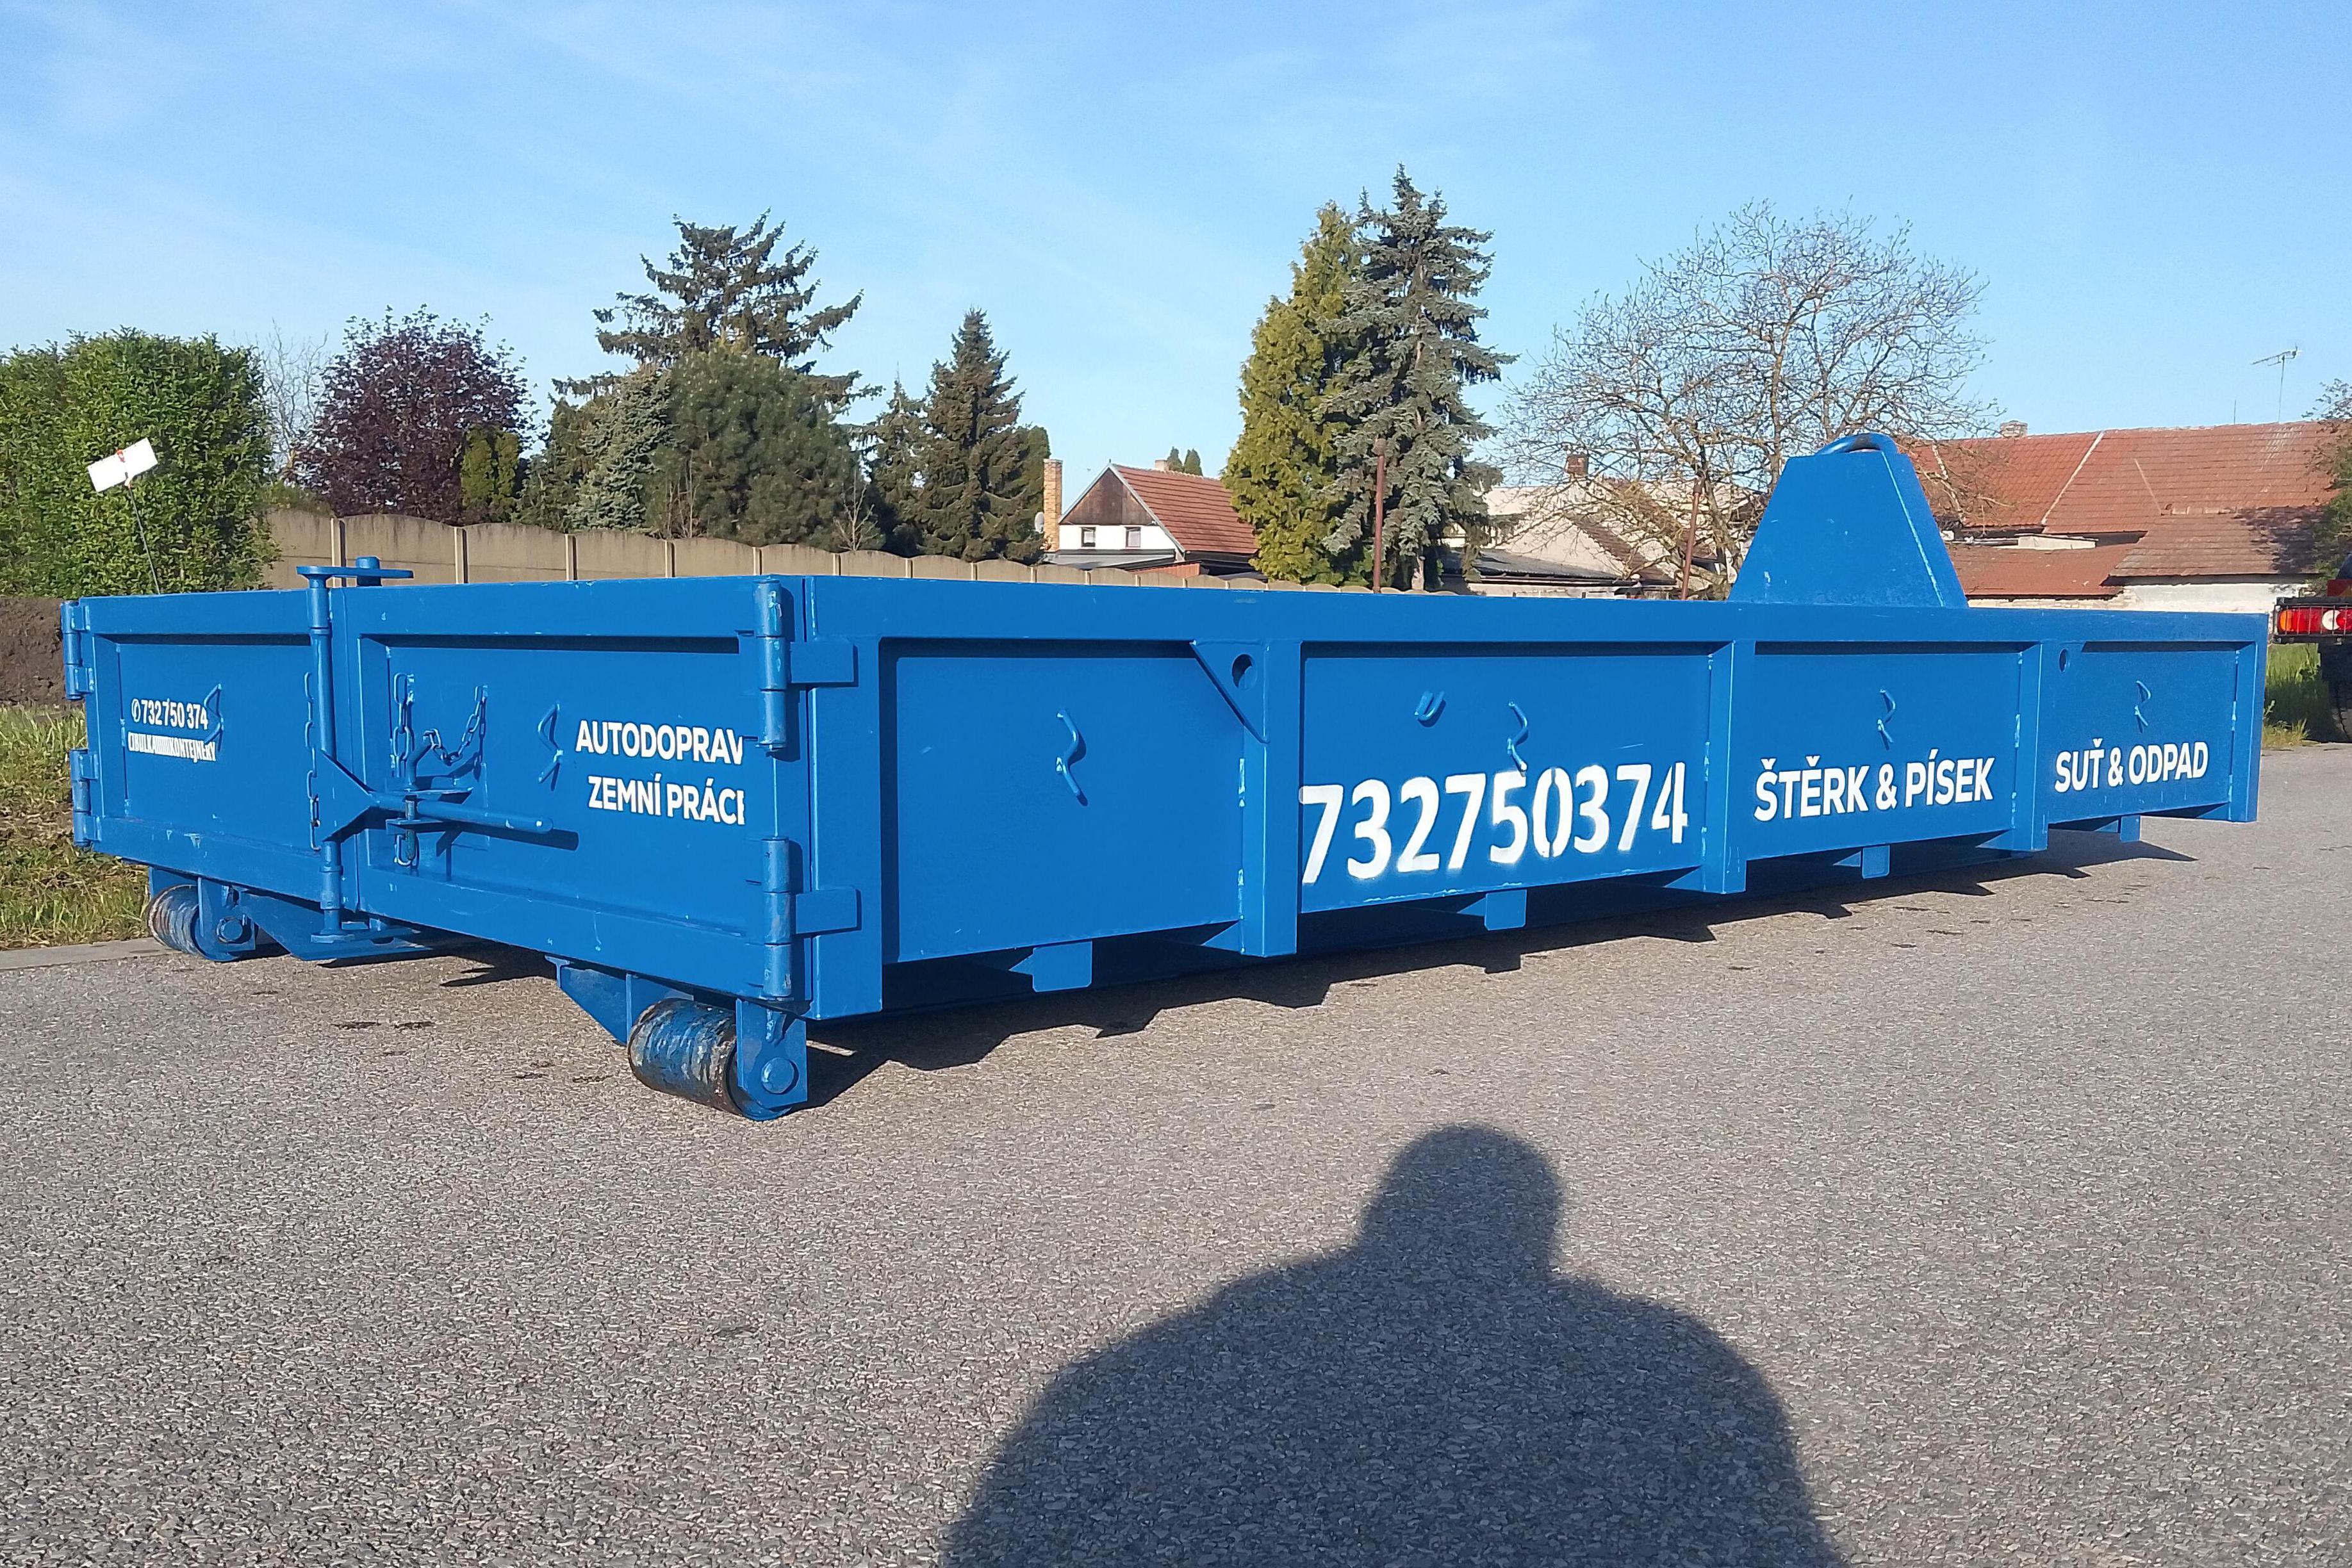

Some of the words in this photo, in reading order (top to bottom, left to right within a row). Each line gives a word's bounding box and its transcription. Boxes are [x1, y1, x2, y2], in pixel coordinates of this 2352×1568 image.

[588, 773, 662, 816] ZEMNÍ
[1754, 755, 1870, 821] ŠTĚRK
[1875, 764, 1897, 810] &
[1905, 749, 1995, 807] PÍSEK
[2055, 738, 2105, 792] SUŤ
[2107, 747, 2124, 787] &
[2128, 742, 2208, 785] ODPAD
[1299, 762, 1688, 885] 732750374
